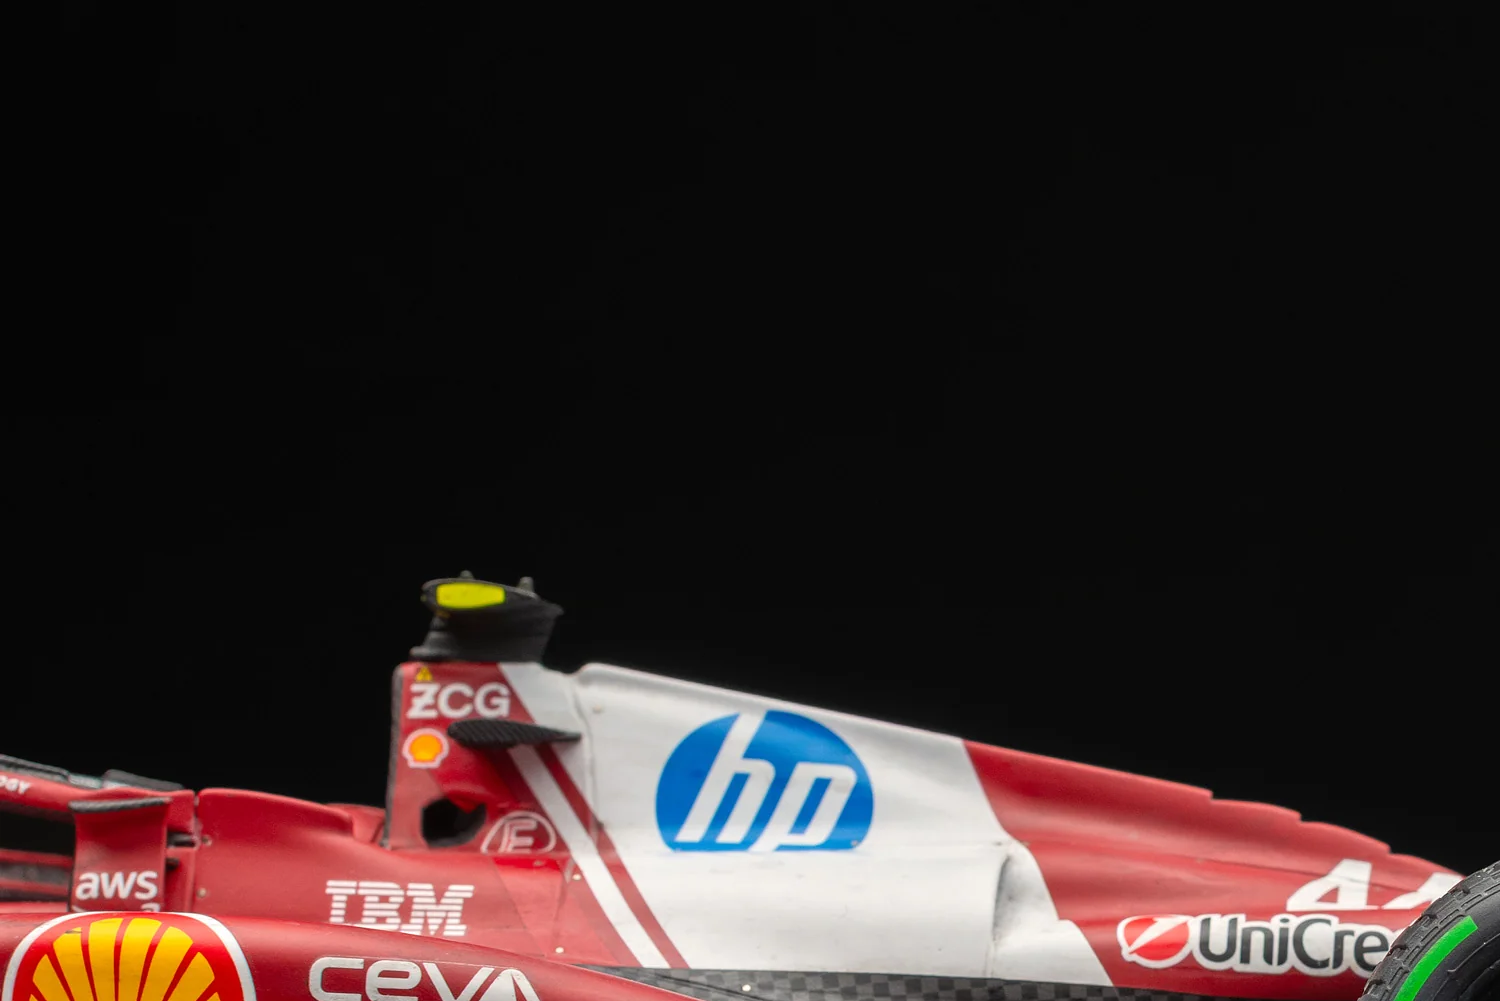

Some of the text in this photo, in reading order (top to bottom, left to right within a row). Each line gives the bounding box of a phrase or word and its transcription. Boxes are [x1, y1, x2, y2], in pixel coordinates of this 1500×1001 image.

[406, 682, 511, 719] ZCG
[674, 711, 858, 852] hp
[75, 870, 158, 900] aws
[325, 880, 475, 936] IBM
